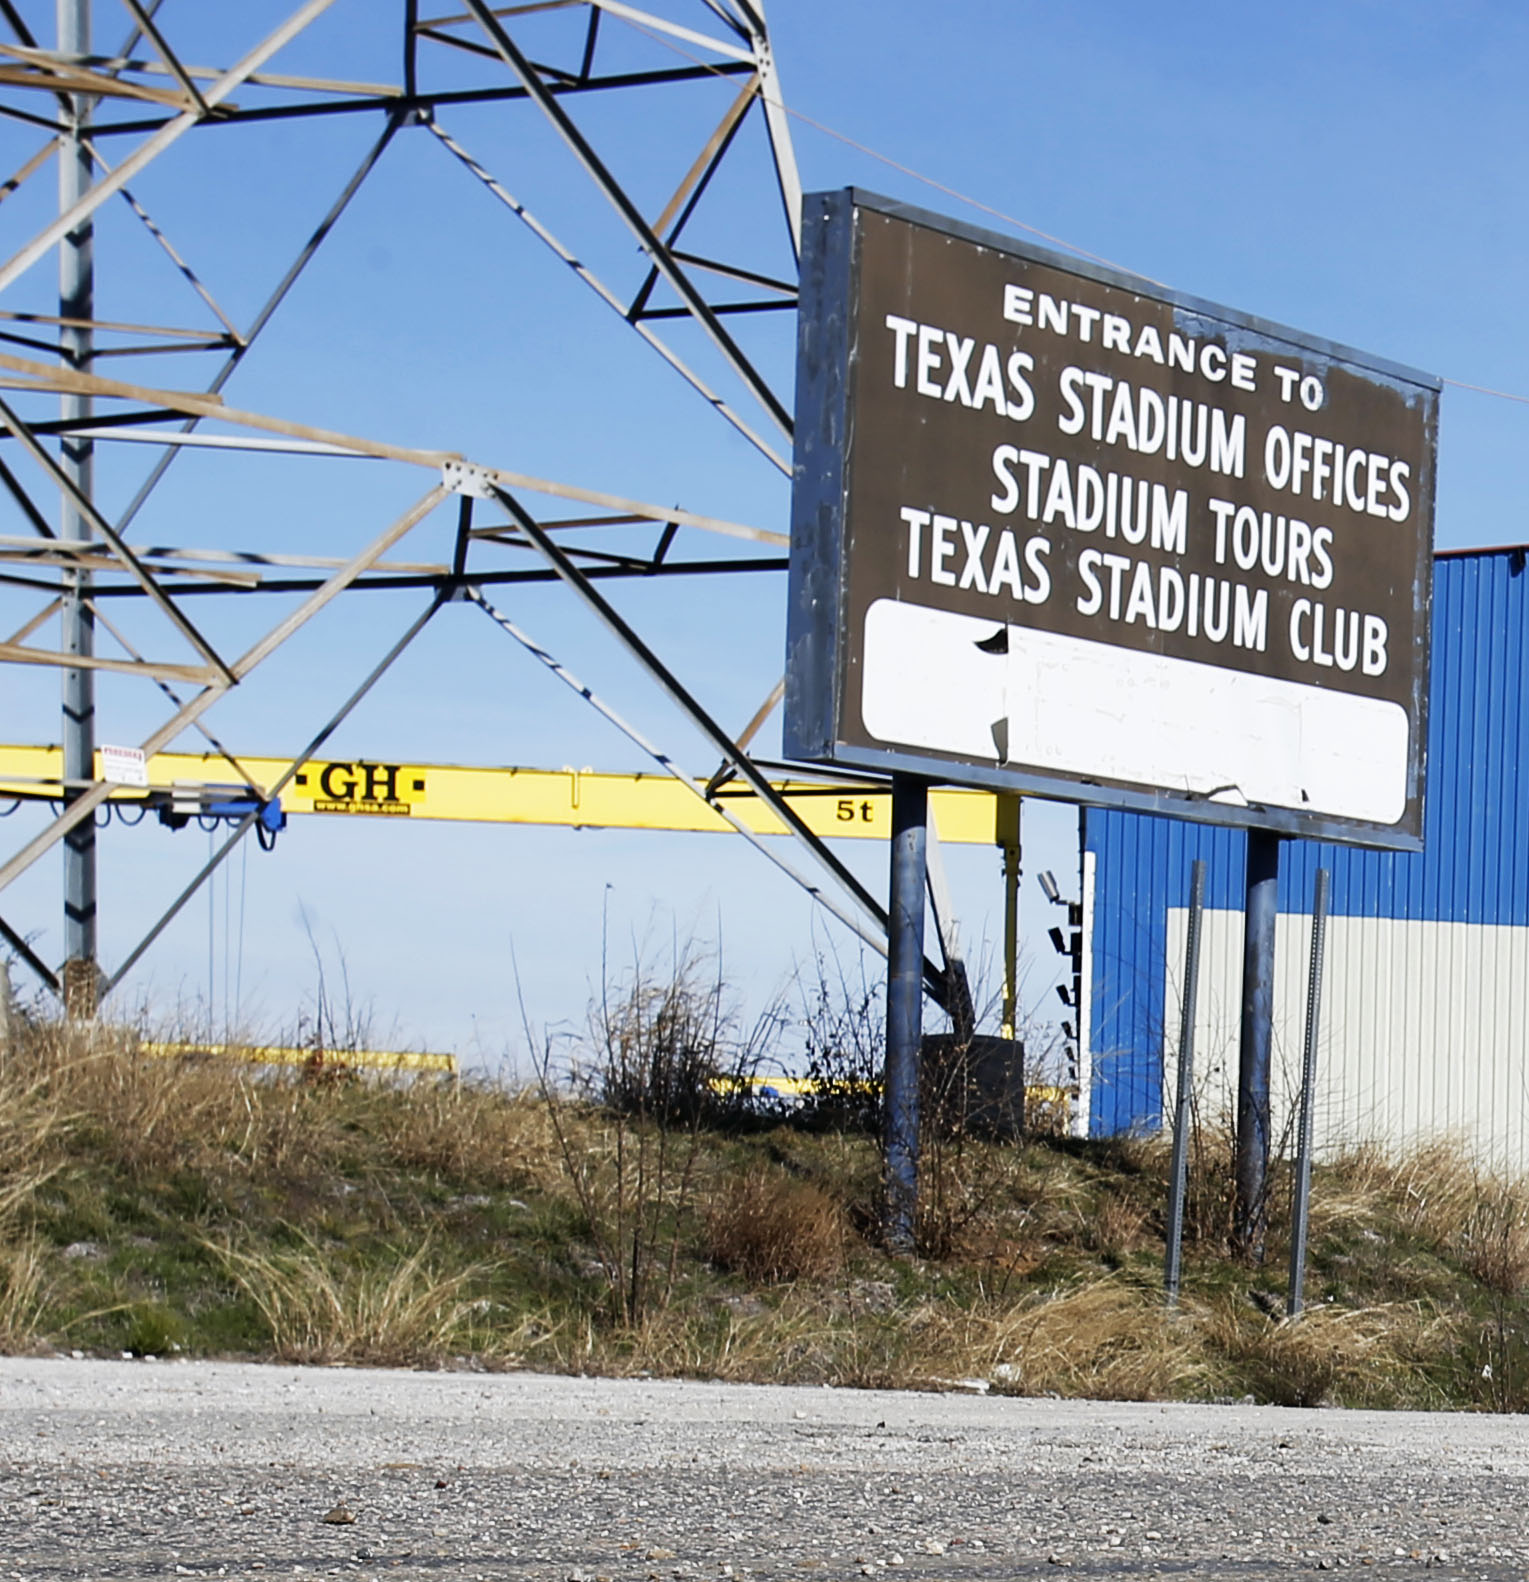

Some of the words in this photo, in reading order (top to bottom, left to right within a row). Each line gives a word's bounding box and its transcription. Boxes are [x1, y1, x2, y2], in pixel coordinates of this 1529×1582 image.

[886, 314, 1035, 421] TEXAS
[1057, 366, 1246, 479] STADIUM
[1264, 425, 1410, 522] OFFICES
[1003, 283, 1257, 392] ENTRANCE
[1273, 365, 1324, 412] TO
[991, 444, 1188, 555] STADIUM
[1208, 498, 1334, 590] TOURS
[900, 506, 1051, 605] TEXAS
[1076, 548, 1268, 652] STADIUM
[1289, 598, 1388, 677] CLUB
[320, 763, 401, 800] GH
